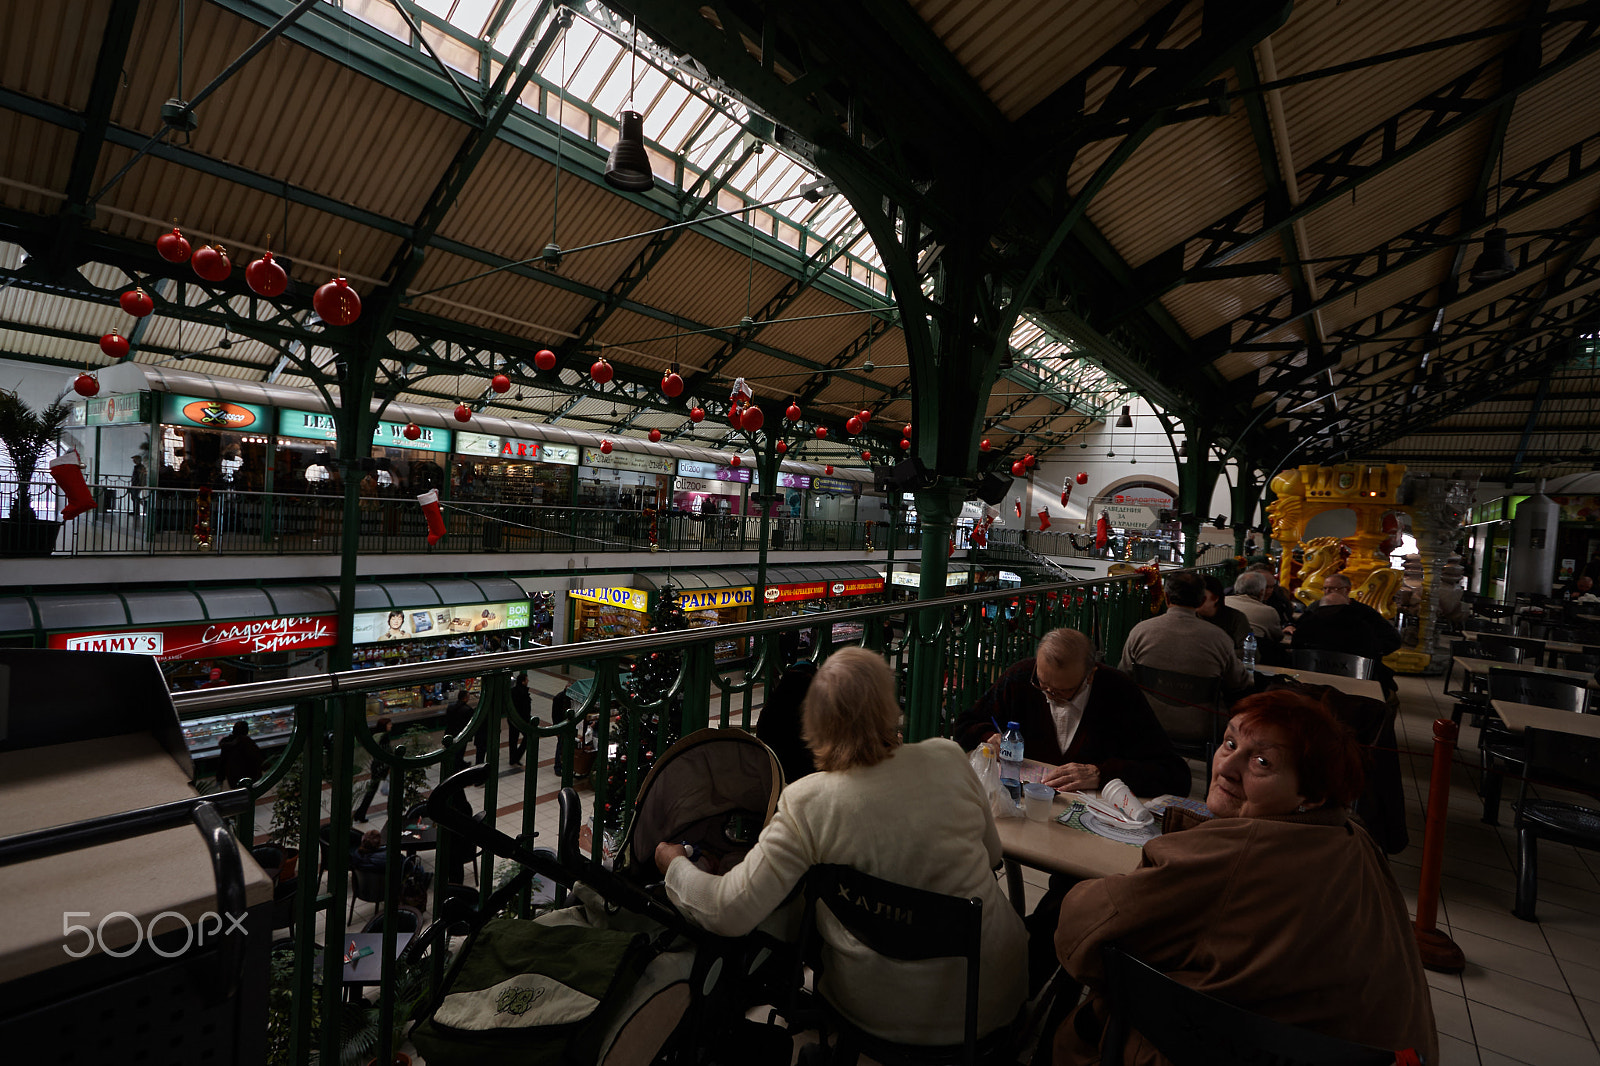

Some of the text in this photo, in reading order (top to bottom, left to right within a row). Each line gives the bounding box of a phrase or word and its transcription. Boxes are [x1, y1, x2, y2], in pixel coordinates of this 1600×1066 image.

[303, 414, 383, 436] LEAR
[390, 424, 434, 441] WR
[502, 442, 540, 457] ART
[680, 462, 701, 474] blizoo
[682, 593, 717, 609] PAIN
[721, 590, 753, 605] D'OR
[509, 605, 528, 615] BON
[507, 617, 529, 627] BONI
